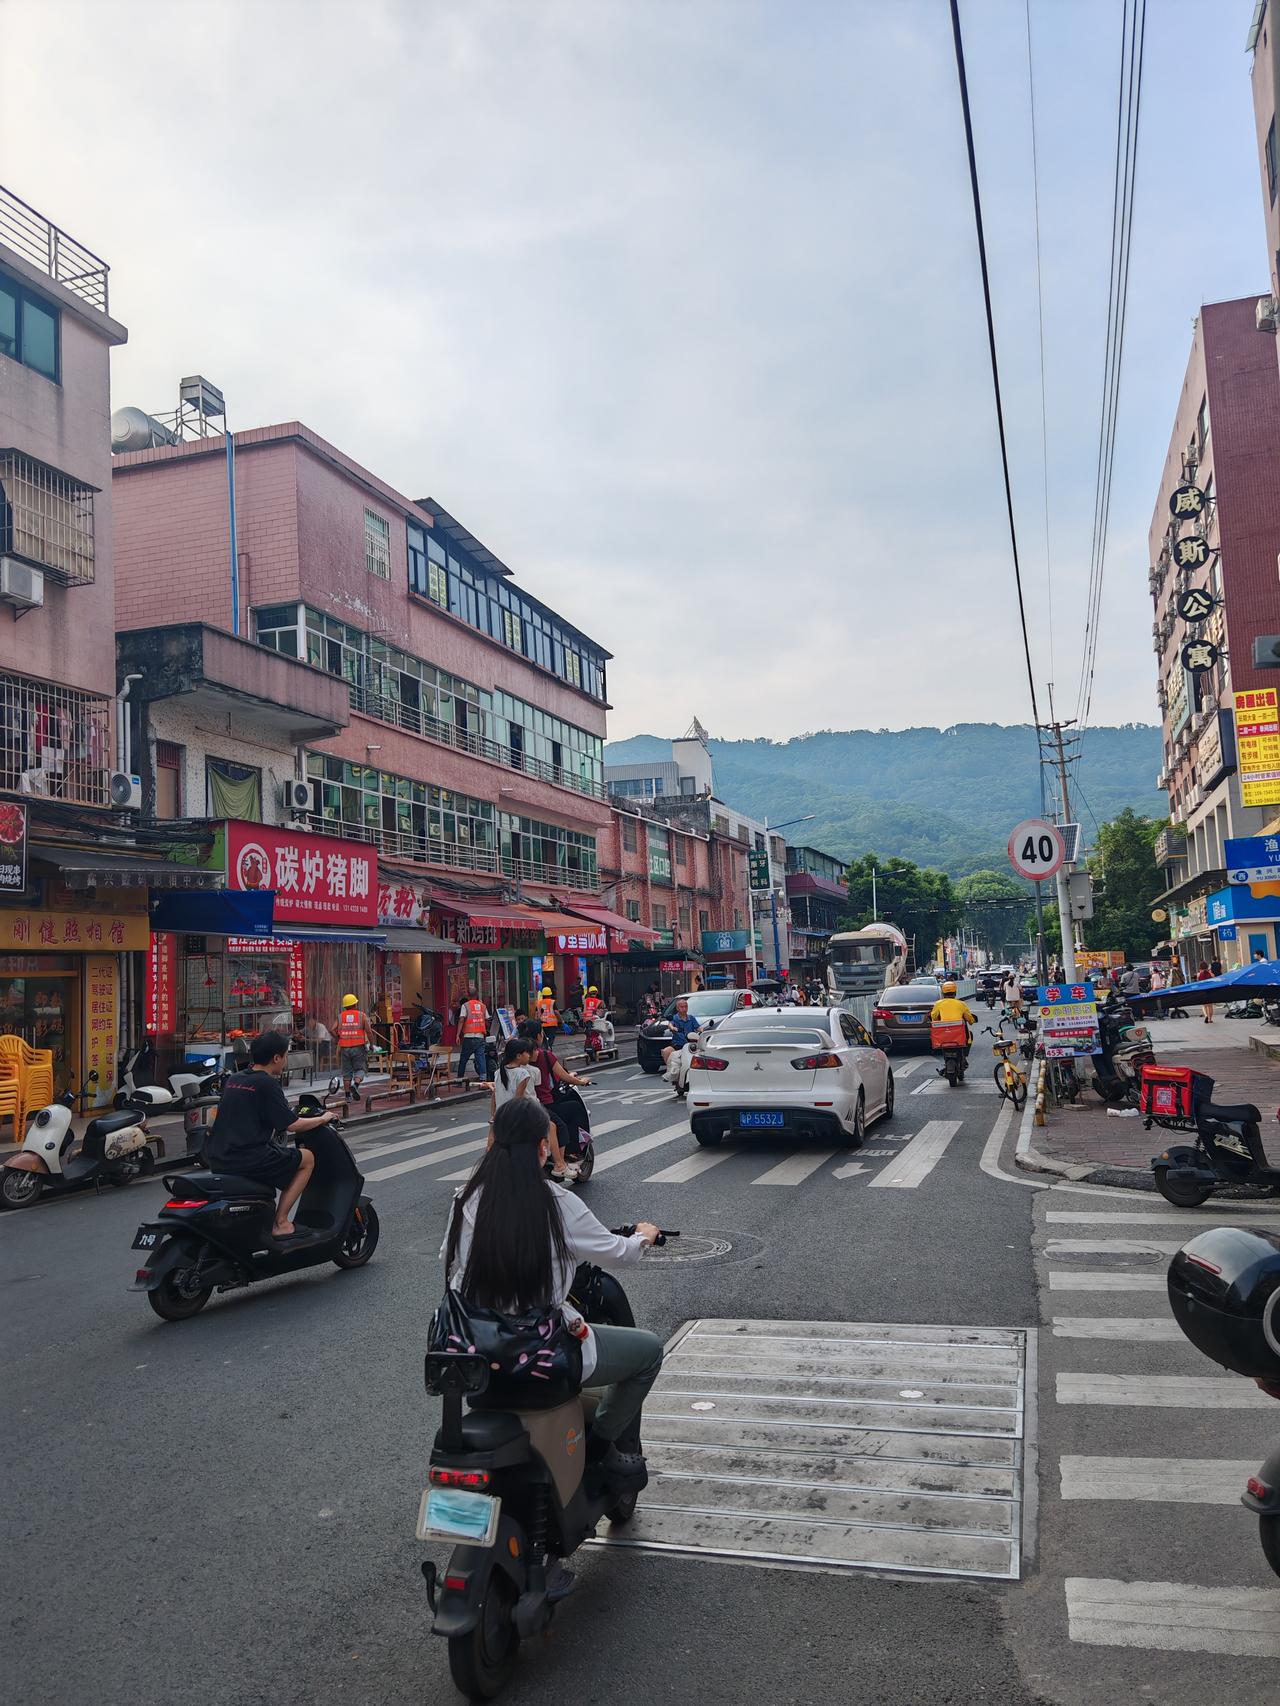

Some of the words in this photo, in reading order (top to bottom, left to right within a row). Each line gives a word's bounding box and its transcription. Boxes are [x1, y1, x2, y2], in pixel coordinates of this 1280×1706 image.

[1174, 487, 1213, 669] 威斯公寓
[1236, 692, 1276, 709] 房屋出租
[1021, 835, 1053, 863] 40
[1264, 838, 1279, 852] 渔
[274, 845, 370, 900] 碳炉猪脚
[1045, 986, 1087, 1003] 学车
[138, 1233, 156, 1247] 九号
